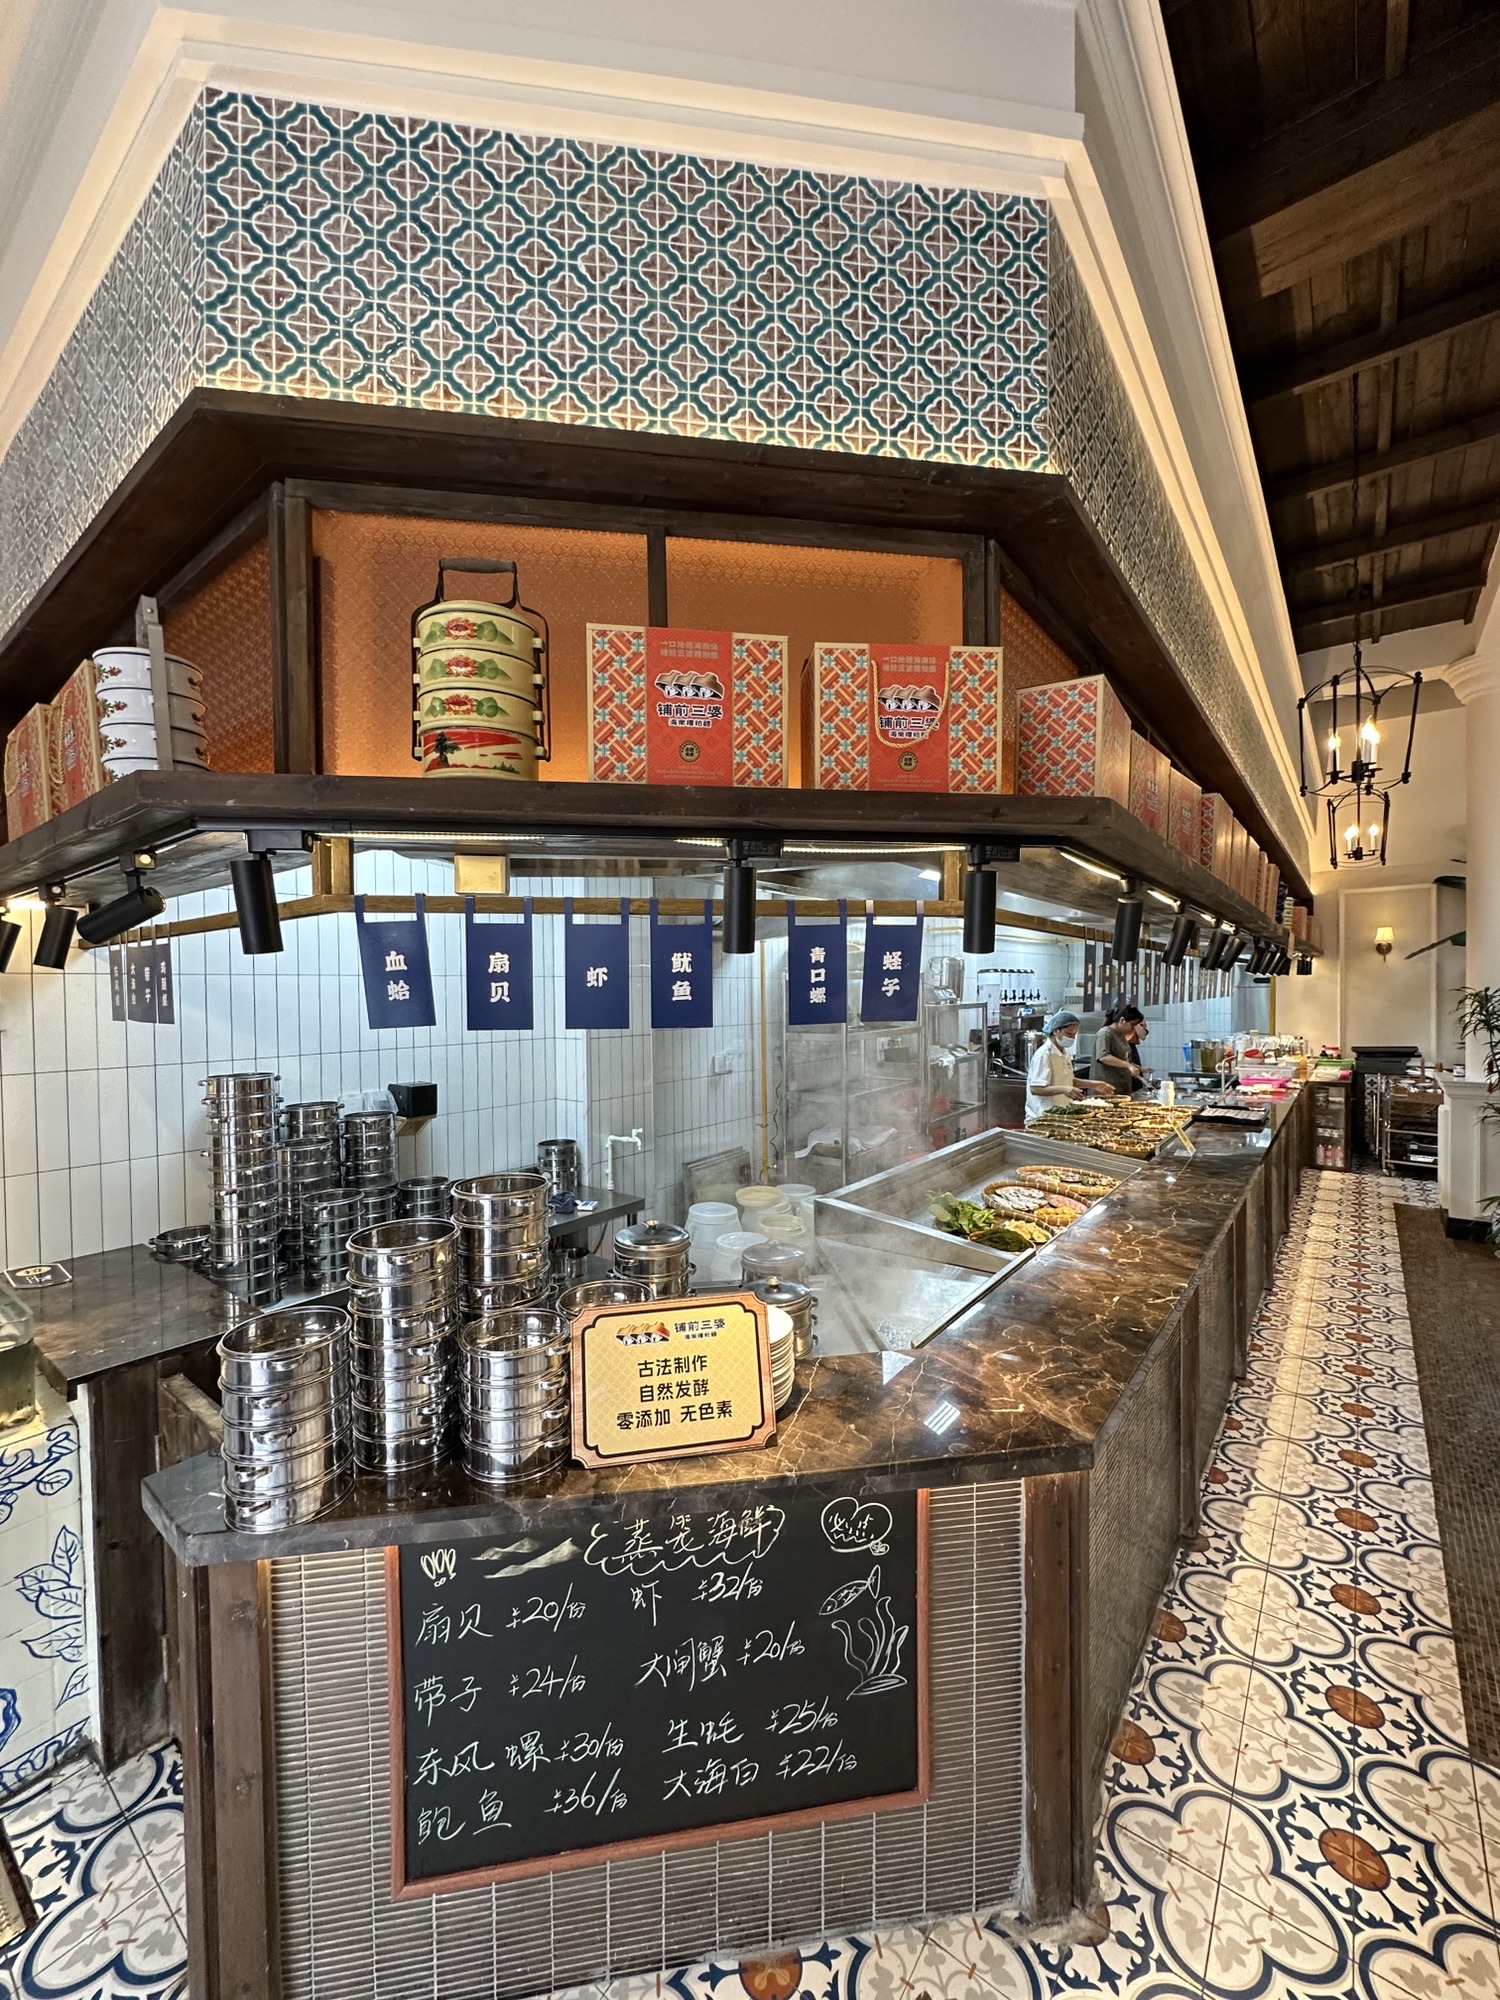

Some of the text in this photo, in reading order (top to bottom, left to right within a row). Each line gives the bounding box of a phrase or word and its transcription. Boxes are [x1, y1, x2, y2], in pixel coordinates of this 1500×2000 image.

[658, 703, 722, 718] 铺前三婆
[385, 951, 409, 1001] 血蛤
[488, 952, 510, 1002] 扇贝
[587, 967, 608, 987] 虾
[671, 952, 692, 1001] 鱿鱼
[810, 947, 826, 1003] 青口螺
[882, 951, 902, 996] 蛏子
[674, 1318, 726, 1333] 铺前三婆
[638, 1355, 707, 1377] 古法制作
[640, 1378, 710, 1403] 自然发酵
[617, 1401, 732, 1429] 零添加 无色素
[415, 1603, 493, 1645] 扇贝
[630, 1580, 662, 1626] 虾
[635, 1636, 726, 1691] 大闸蟹
[414, 1675, 482, 1727] 带子
[662, 1711, 744, 1753] 生蚝
[663, 1758, 759, 1800] 大海白
